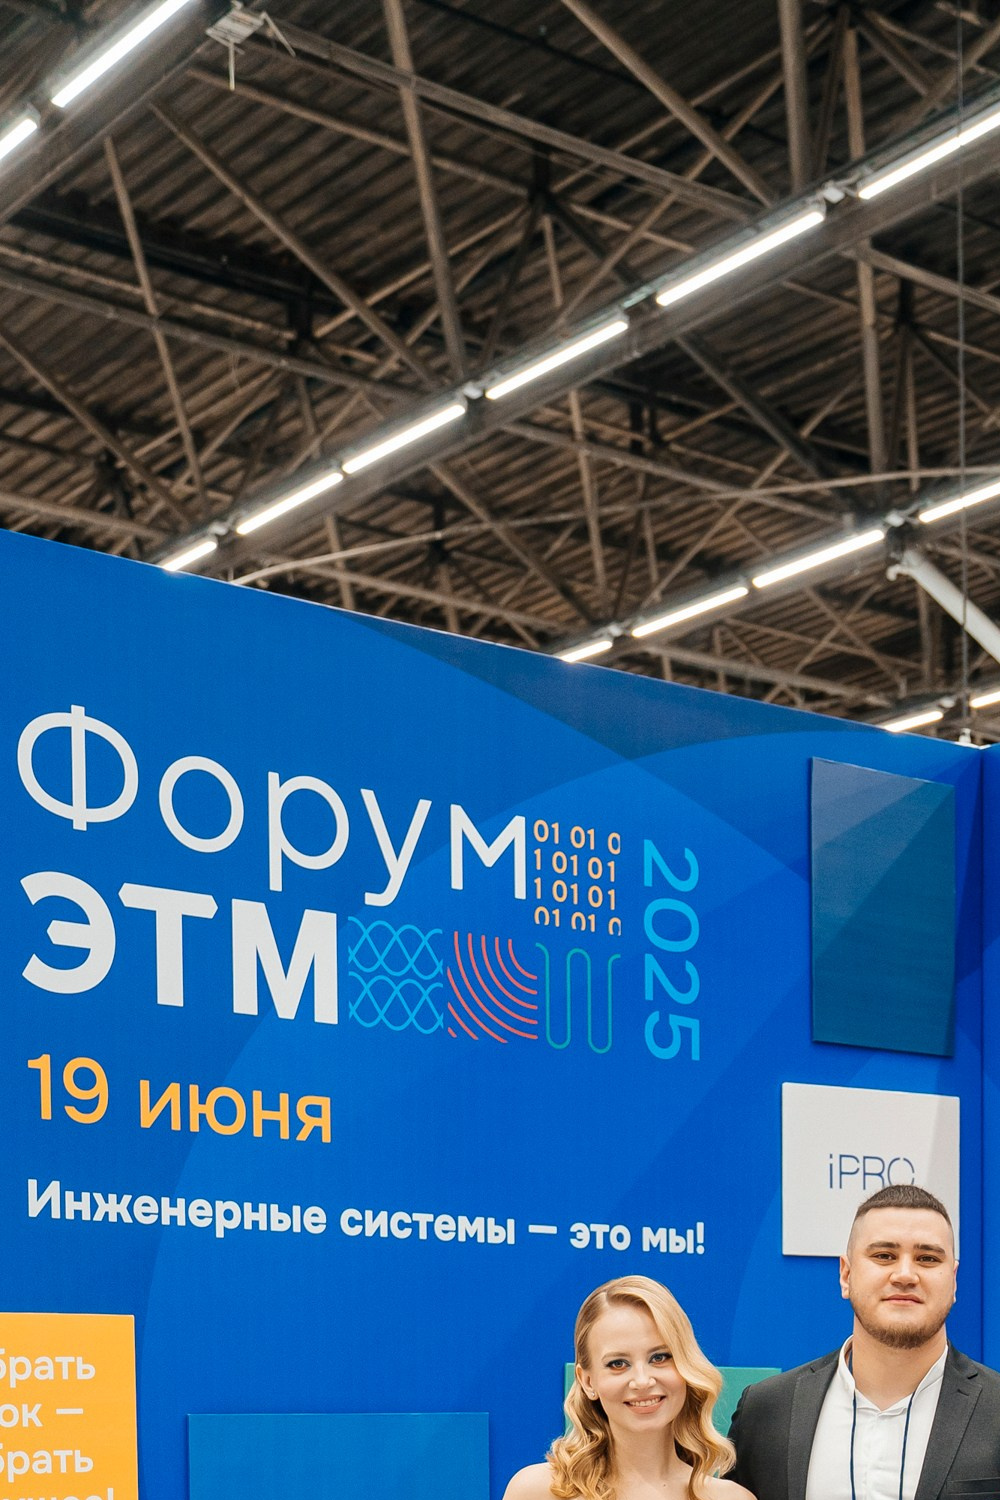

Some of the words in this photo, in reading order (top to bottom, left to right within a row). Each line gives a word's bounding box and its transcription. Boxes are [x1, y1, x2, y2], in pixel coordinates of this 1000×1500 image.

[18, 704, 527, 907] Форум
[20, 871, 339, 1025] ЭТМ
[643, 838, 700, 1061] 2025
[27, 1053, 109, 1124] 19
[139, 1079, 331, 1143] июня
[27, 1178, 327, 1238] Инженерные
[340, 1208, 515, 1245] системы
[570, 1222, 631, 1251] это
[642, 1222, 705, 1255] мы!
[0, 1442, 94, 1483] рать
